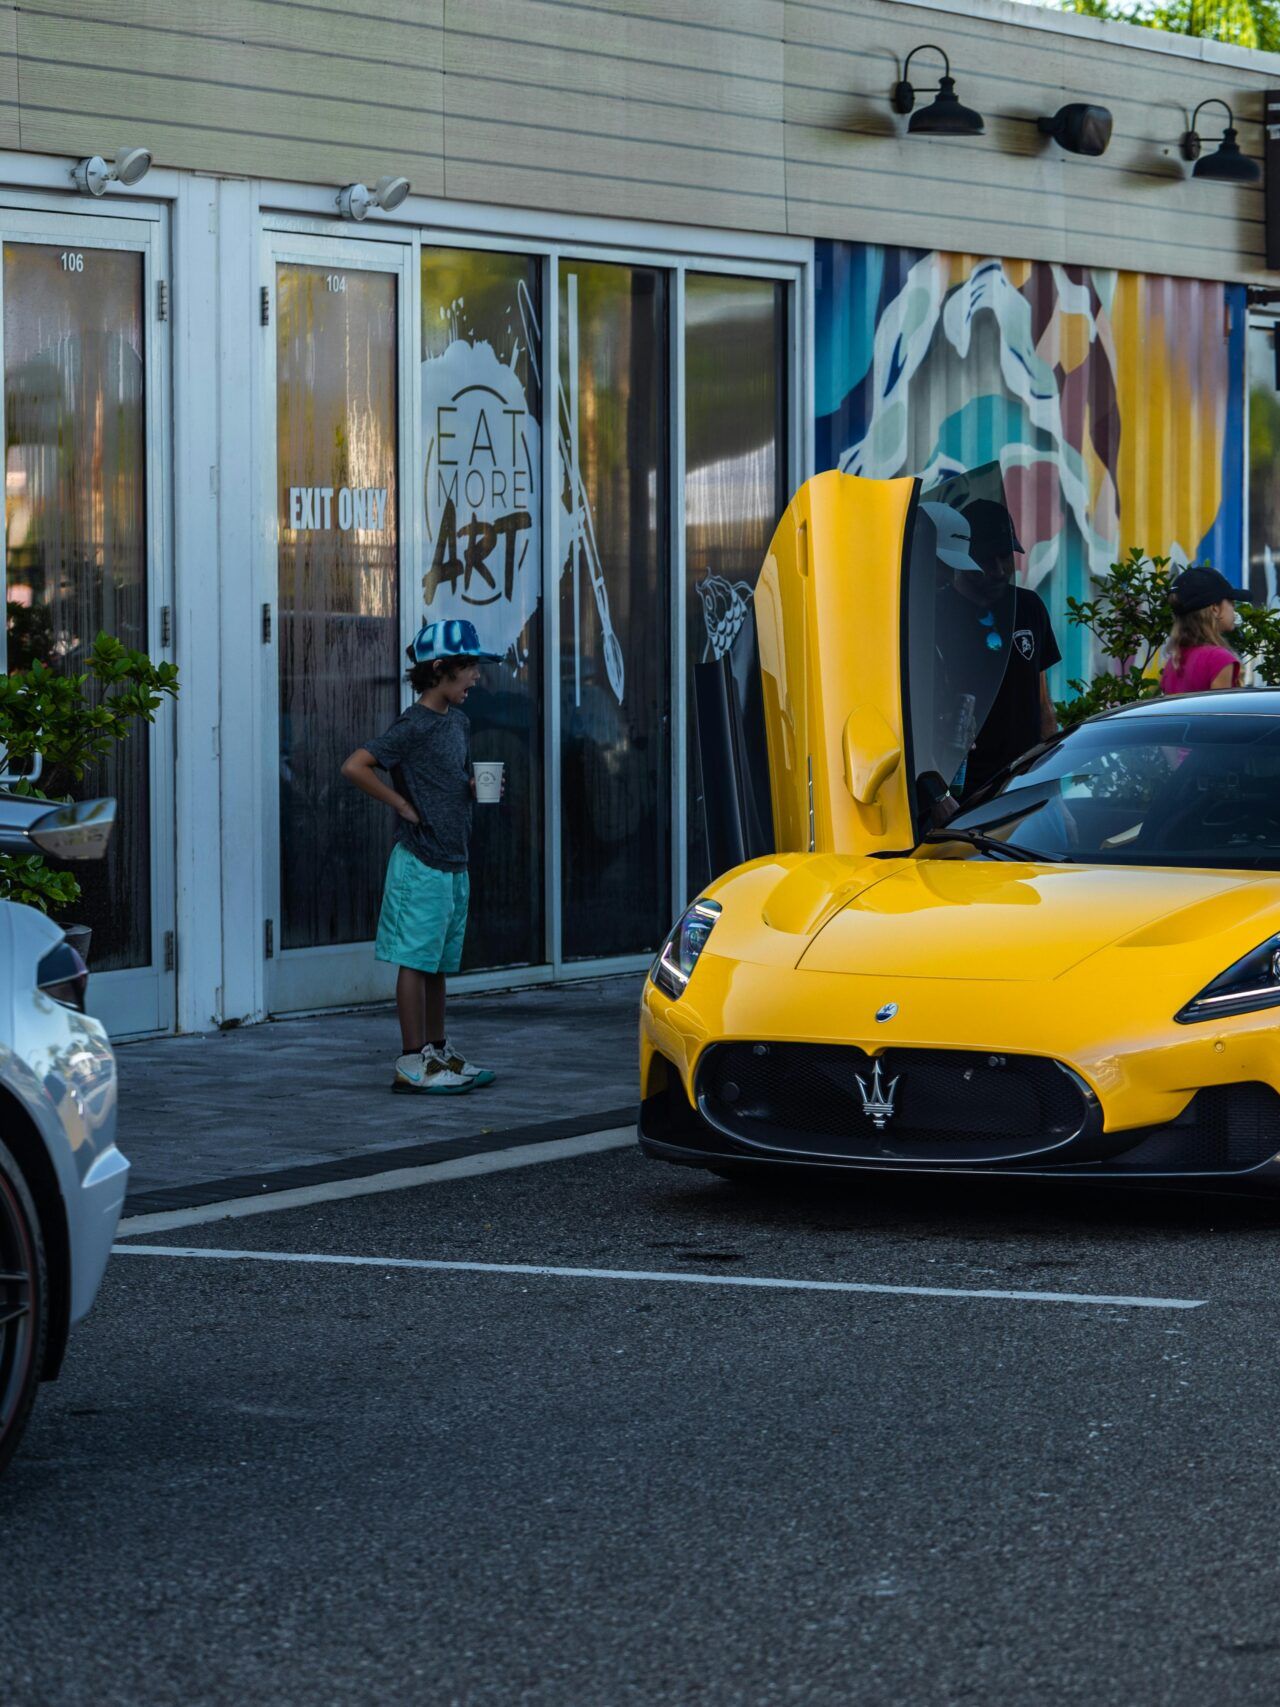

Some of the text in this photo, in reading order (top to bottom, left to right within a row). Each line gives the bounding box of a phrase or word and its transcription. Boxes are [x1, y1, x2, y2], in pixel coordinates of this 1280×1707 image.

[61, 252, 84, 272] 106
[326, 274, 346, 293] 104
[437, 406, 526, 468] EAT
[289, 486, 387, 531] EXIT ONLY
[437, 468, 527, 510] MORE
[421, 498, 533, 606] ART
